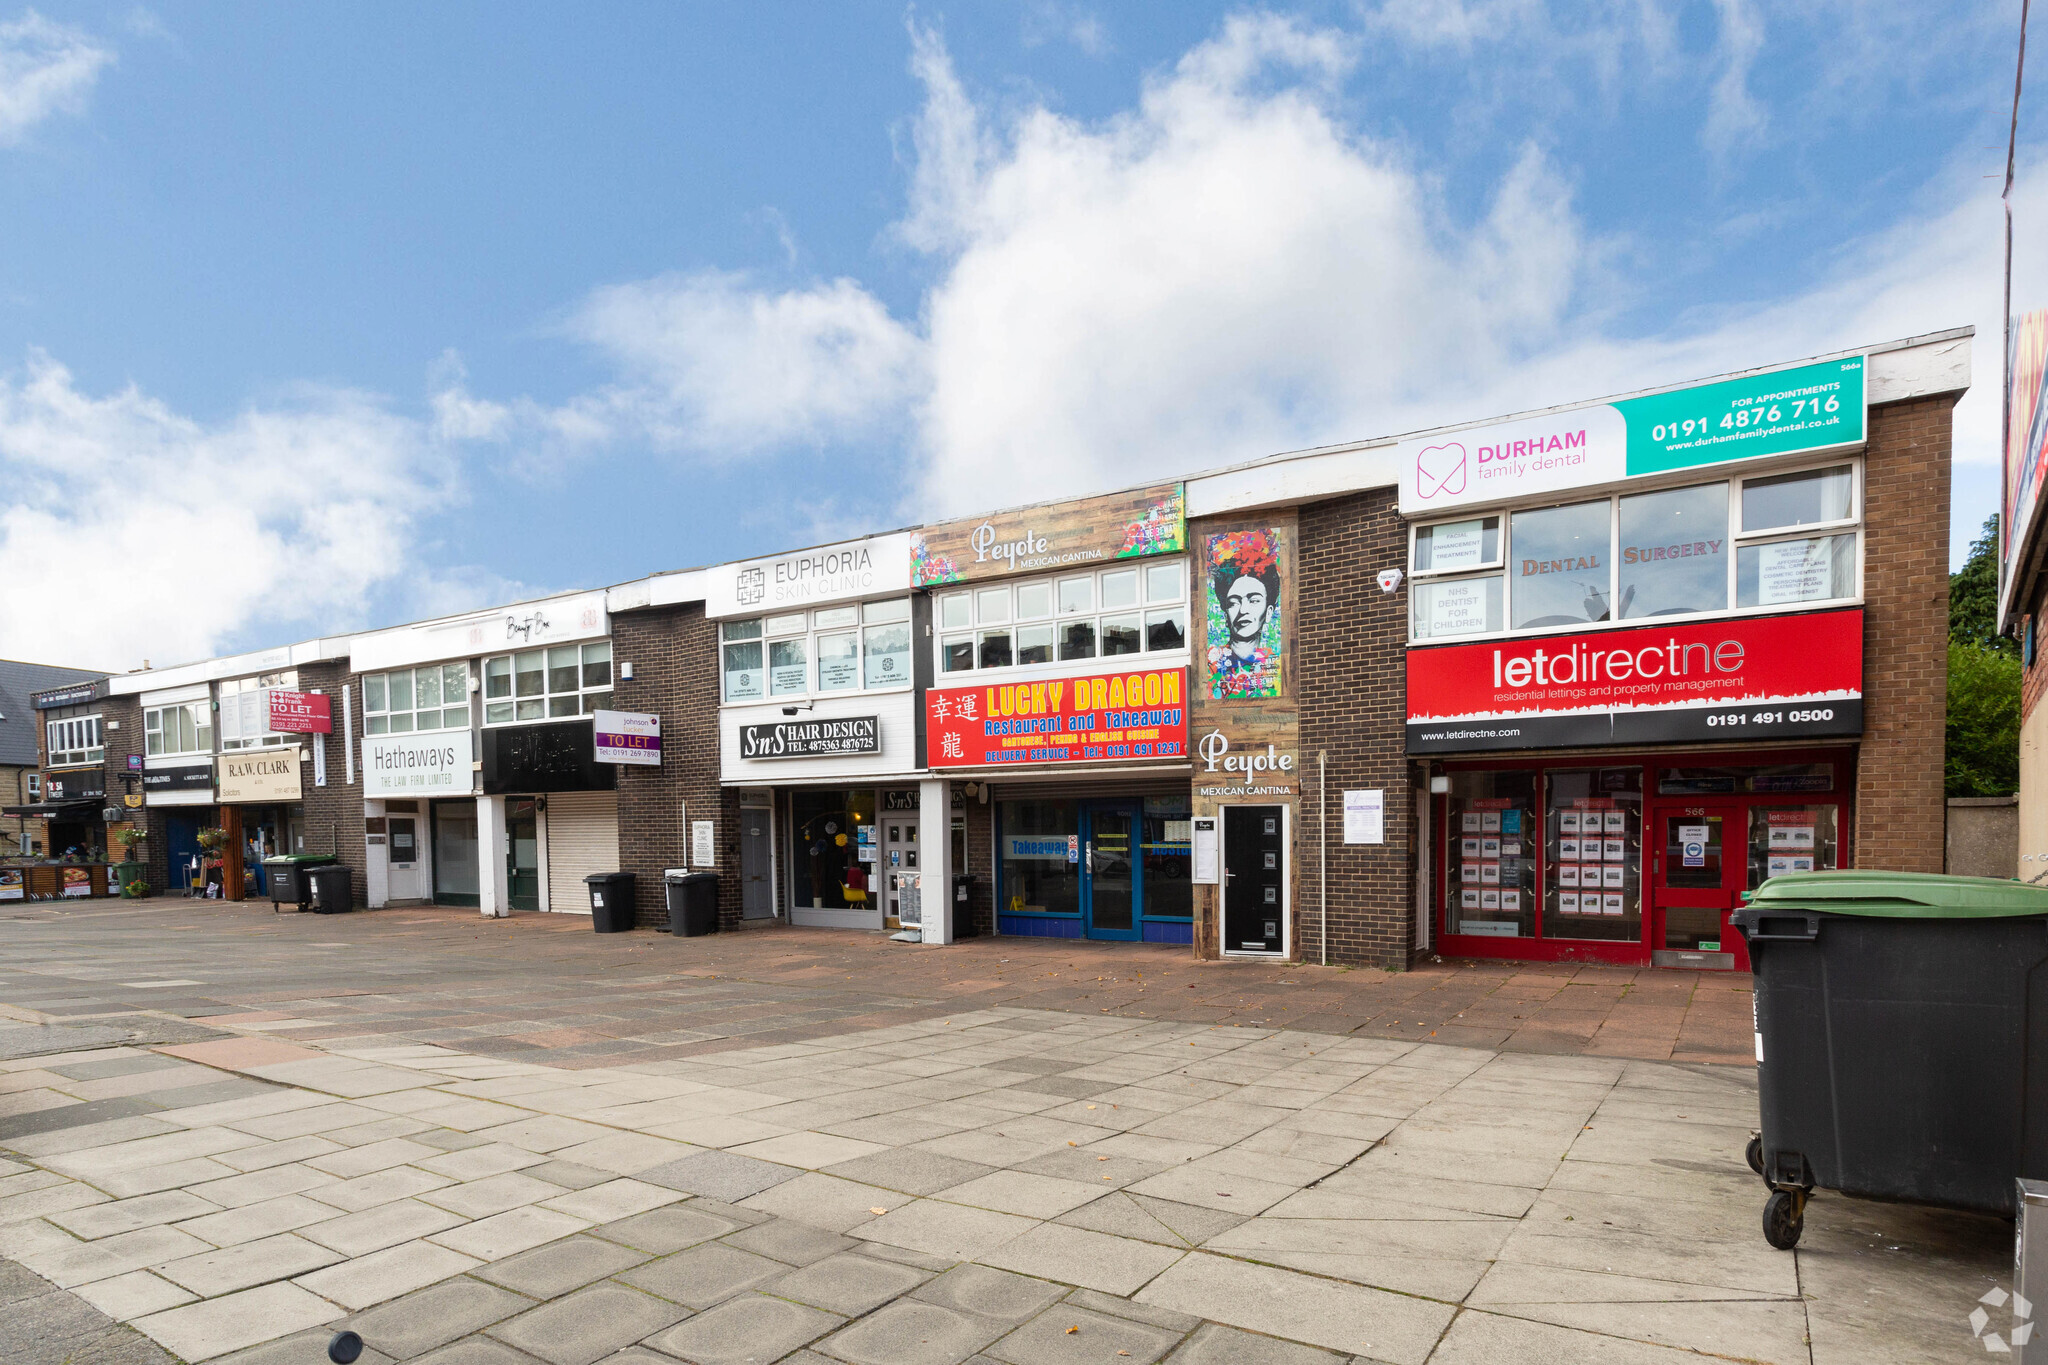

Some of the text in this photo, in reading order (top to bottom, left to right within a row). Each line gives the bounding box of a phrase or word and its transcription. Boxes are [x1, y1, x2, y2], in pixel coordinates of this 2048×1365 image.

[1840, 362, 1862, 372] 566a
[1731, 381, 1841, 409] FOR APPOINTMENTS
[1652, 394, 1840, 442] 0191 4876 716
[1665, 415, 1840, 451] www.durhamfamilydental.co.uk
[1478, 429, 1586, 464] DURHAM
[1478, 448, 1586, 480] family dental
[970, 519, 1048, 571] Peyote
[1433, 540, 1481, 551] ENHANCEMENT
[1446, 532, 1468, 540] FACIAL
[1019, 549, 1103, 570] MEXICAN CANTINA
[1436, 549, 1477, 559] TREATMENTS
[1521, 539, 1724, 577] DENTAL SURGERY
[775, 548, 873, 584] EUPHORIA
[775, 572, 873, 601] SKIN CLINIC
[1448, 587, 1469, 597] NHS
[1438, 596, 1479, 608] DENTIST
[1448, 608, 1468, 618] FOR
[1433, 618, 1483, 630] CHILDREN
[1493, 637, 1746, 689] letdirectne
[284, 692, 306, 700] Knight
[986, 671, 1181, 718] LUCKY DRAGON
[1493, 676, 1745, 703] residential lettings and property management
[271, 703, 313, 714] TO LET
[930, 693, 980, 725] 幸運
[1706, 709, 1834, 727] 0191 491 0500
[623, 717, 649, 726] johnson
[786, 724, 821, 741] HAIR
[822, 719, 875, 739] DESIGN
[984, 707, 1182, 736] Restaurant and Takeaway
[607, 734, 650, 748] TO LET
[1001, 728, 1160, 748] CANTONESE, PEKING & ENGLISH CUISINE
[1421, 727, 1521, 741] www.letdirectne.com
[599, 748, 659, 758] Tel: 0191 269 7890
[786, 741, 807, 753] TEL:
[808, 739, 840, 751] 4875363
[841, 737, 875, 750] 4876725
[940, 731, 965, 759] 龍
[985, 749, 1028, 763] DELIVERY
[1030, 747, 1070, 760] SERVICE
[1084, 746, 1102, 758] Tel:
[1107, 744, 1130, 757] 0191
[1133, 743, 1153, 756] 491
[1157, 742, 1181, 755] 1231
[374, 744, 455, 772] Hathaways
[1198, 728, 1293, 785] Peyote
[228, 759, 290, 778] R.A.W. CLARK
[381, 773, 453, 788] THE LAW FIRM LIMITED
[1200, 785, 1291, 796] MEXICAN CANTINA
[1685, 807, 1706, 816] 566
[1012, 840, 1069, 856] Takeaway
